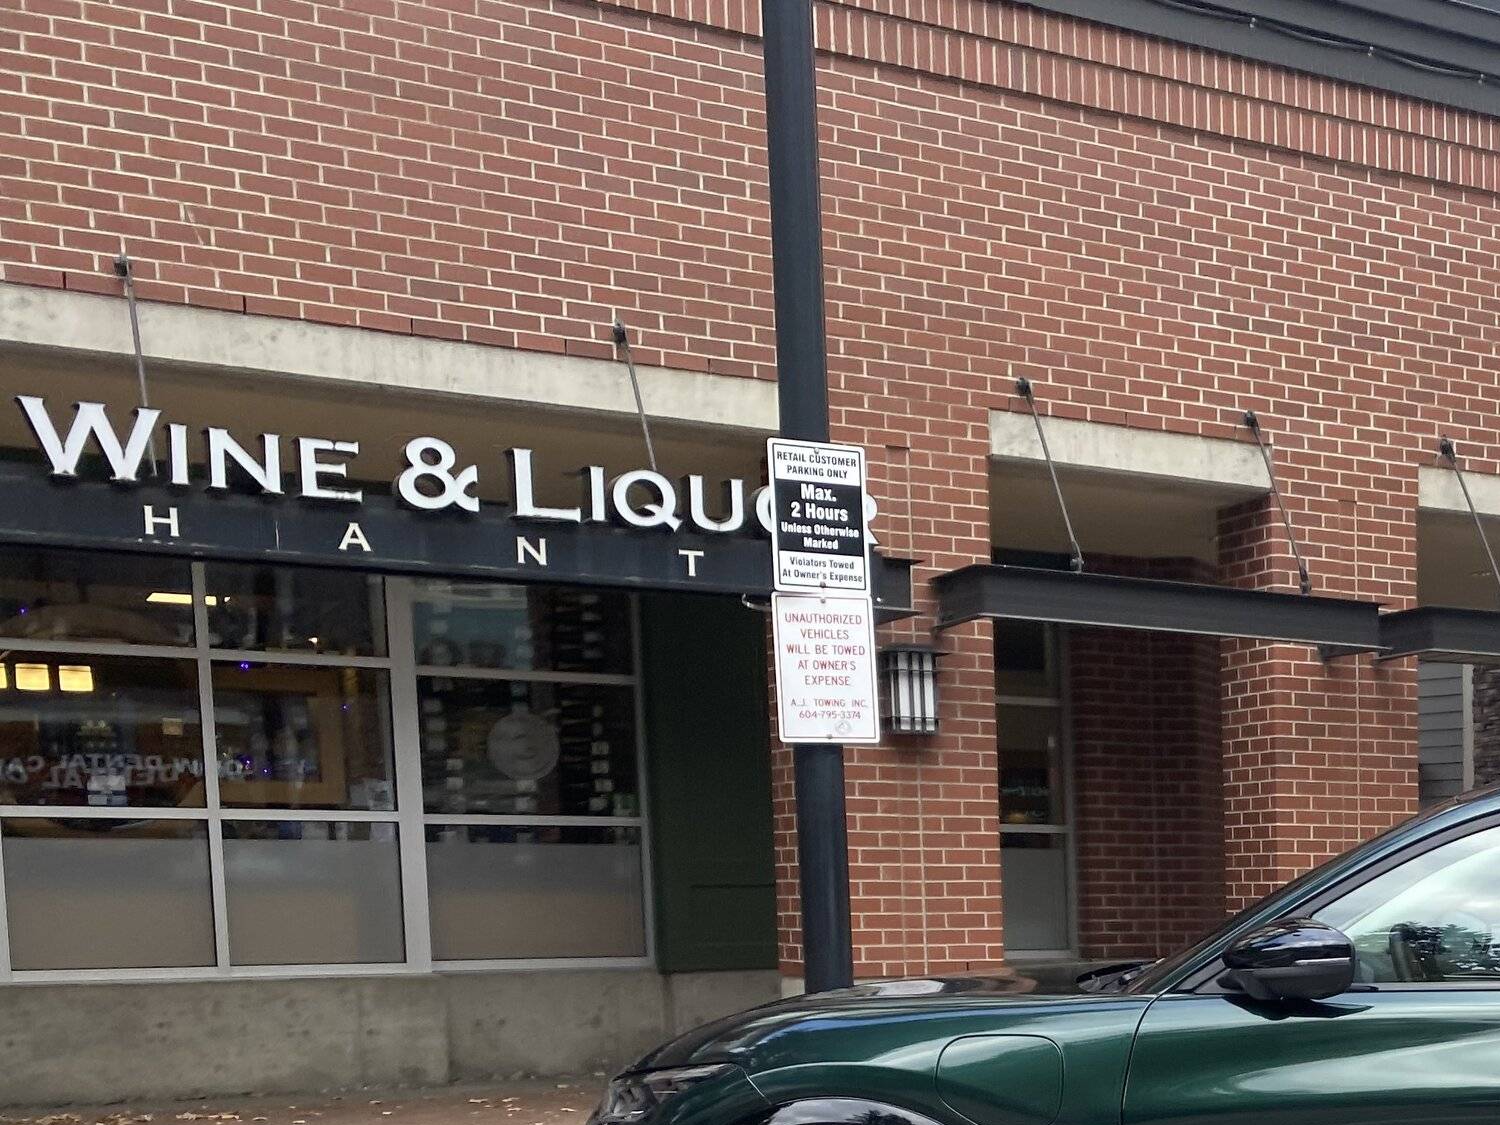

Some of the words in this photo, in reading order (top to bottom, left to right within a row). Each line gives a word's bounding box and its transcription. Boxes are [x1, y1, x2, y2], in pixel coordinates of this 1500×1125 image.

[15, 395, 363, 502] WINE
[398, 436, 479, 513] &
[777, 452, 806, 462] RETAIL
[809, 454, 856, 467] CUSTOMER
[787, 465, 824, 476] PARKING
[827, 469, 848, 479] ONLY
[800, 483, 836, 502] Max.
[791, 502, 800, 517] 2
[806, 503, 848, 522] Hours
[781, 522, 811, 534] Unless
[814, 524, 859, 538] Otherwise
[804, 537, 838, 549] Marked
[790, 557, 826, 567] Violators
[830, 560, 854, 569] Towed
[782, 569, 791, 577] At
[794, 569, 826, 580] Owner's
[830, 572, 862, 583] Expense
[785, 613, 862, 625] UNAUTHORIZED
[800, 629, 849, 639] VEHICLES
[786, 644, 810, 654] WILL
[815, 645, 829, 655] BE
[832, 645, 865, 656] TOWED
[798, 660, 809, 669] AT
[815, 699, 845, 707] TOWING
[799, 710, 861, 719] 604-795-3374
